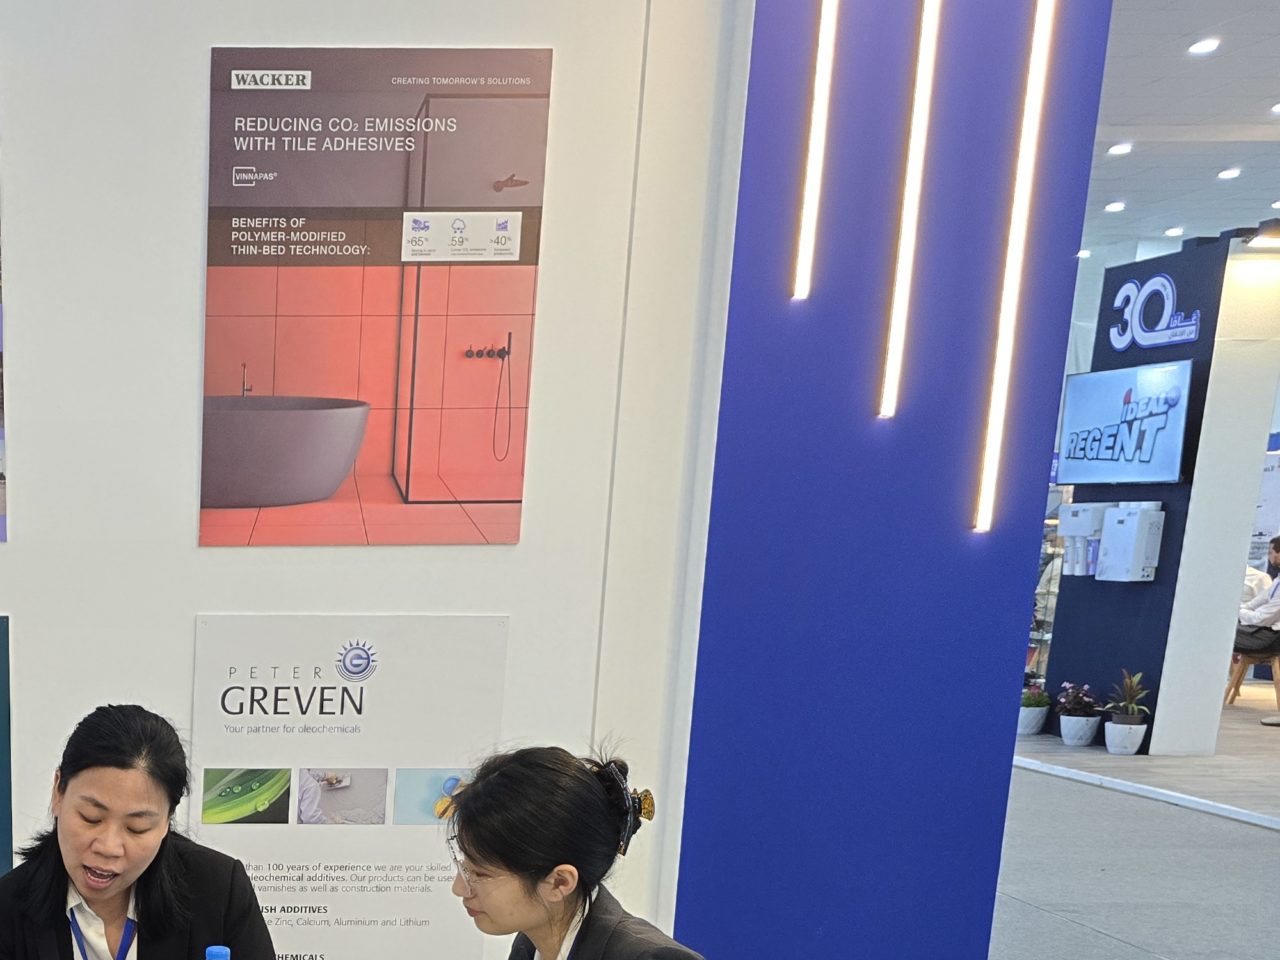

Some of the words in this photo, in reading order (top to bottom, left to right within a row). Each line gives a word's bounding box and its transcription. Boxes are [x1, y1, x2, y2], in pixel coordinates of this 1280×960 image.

[234, 73, 308, 87] WACKER
[391, 77, 430, 86] CREATING
[432, 76, 486, 86] TOMORROW'S
[487, 76, 531, 86] SOLUTIONS
[234, 117, 322, 133] REDUCING
[364, 117, 457, 132] EMISSIONS
[234, 137, 276, 151] WITH
[281, 137, 316, 151] TILE
[321, 137, 416, 151] ADHESIVES
[231, 217, 287, 228] BENEFITS
[290, 217, 306, 228] OF
[231, 231, 346, 242] POLYMER-MODIFIED
[231, 245, 286, 255] THIN-BED
[289, 245, 371, 255] TECHNOLOGY:
[1109, 272, 1182, 351] 30
[1065, 413, 1168, 463] REGENT
[229, 666, 322, 679] PETER
[220, 686, 364, 715] GREVEN
[224, 724, 244, 734] Your
[247, 724, 281, 734] partner
[282, 724, 296, 733] for
[297, 723, 361, 734] oleochemicals
[246, 863, 263, 871] than
[268, 863, 284, 871] 100
[287, 864, 309, 873] years
[312, 863, 321, 871] of
[323, 863, 371, 873] experience
[404, 865, 423, 873] your
[426, 862, 451, 871] skilled
[250, 873, 304, 881] leochemical
[307, 873, 346, 881] additives.
[350, 873, 367, 882] Our
[368, 873, 405, 884] products
[424, 873, 435, 881] be
[258, 884, 296, 892] varnishes
[310, 884, 327, 892] well
[341, 884, 391, 892] construction
[393, 884, 433, 892] materials.
[279, 905, 328, 913] ADDITIVES
[275, 917, 293, 927] Zinc,
[296, 917, 331, 927] Calcium,
[333, 917, 378, 926] Aluminium
[380, 917, 397, 926] and
[399, 917, 430, 926] Lithium
